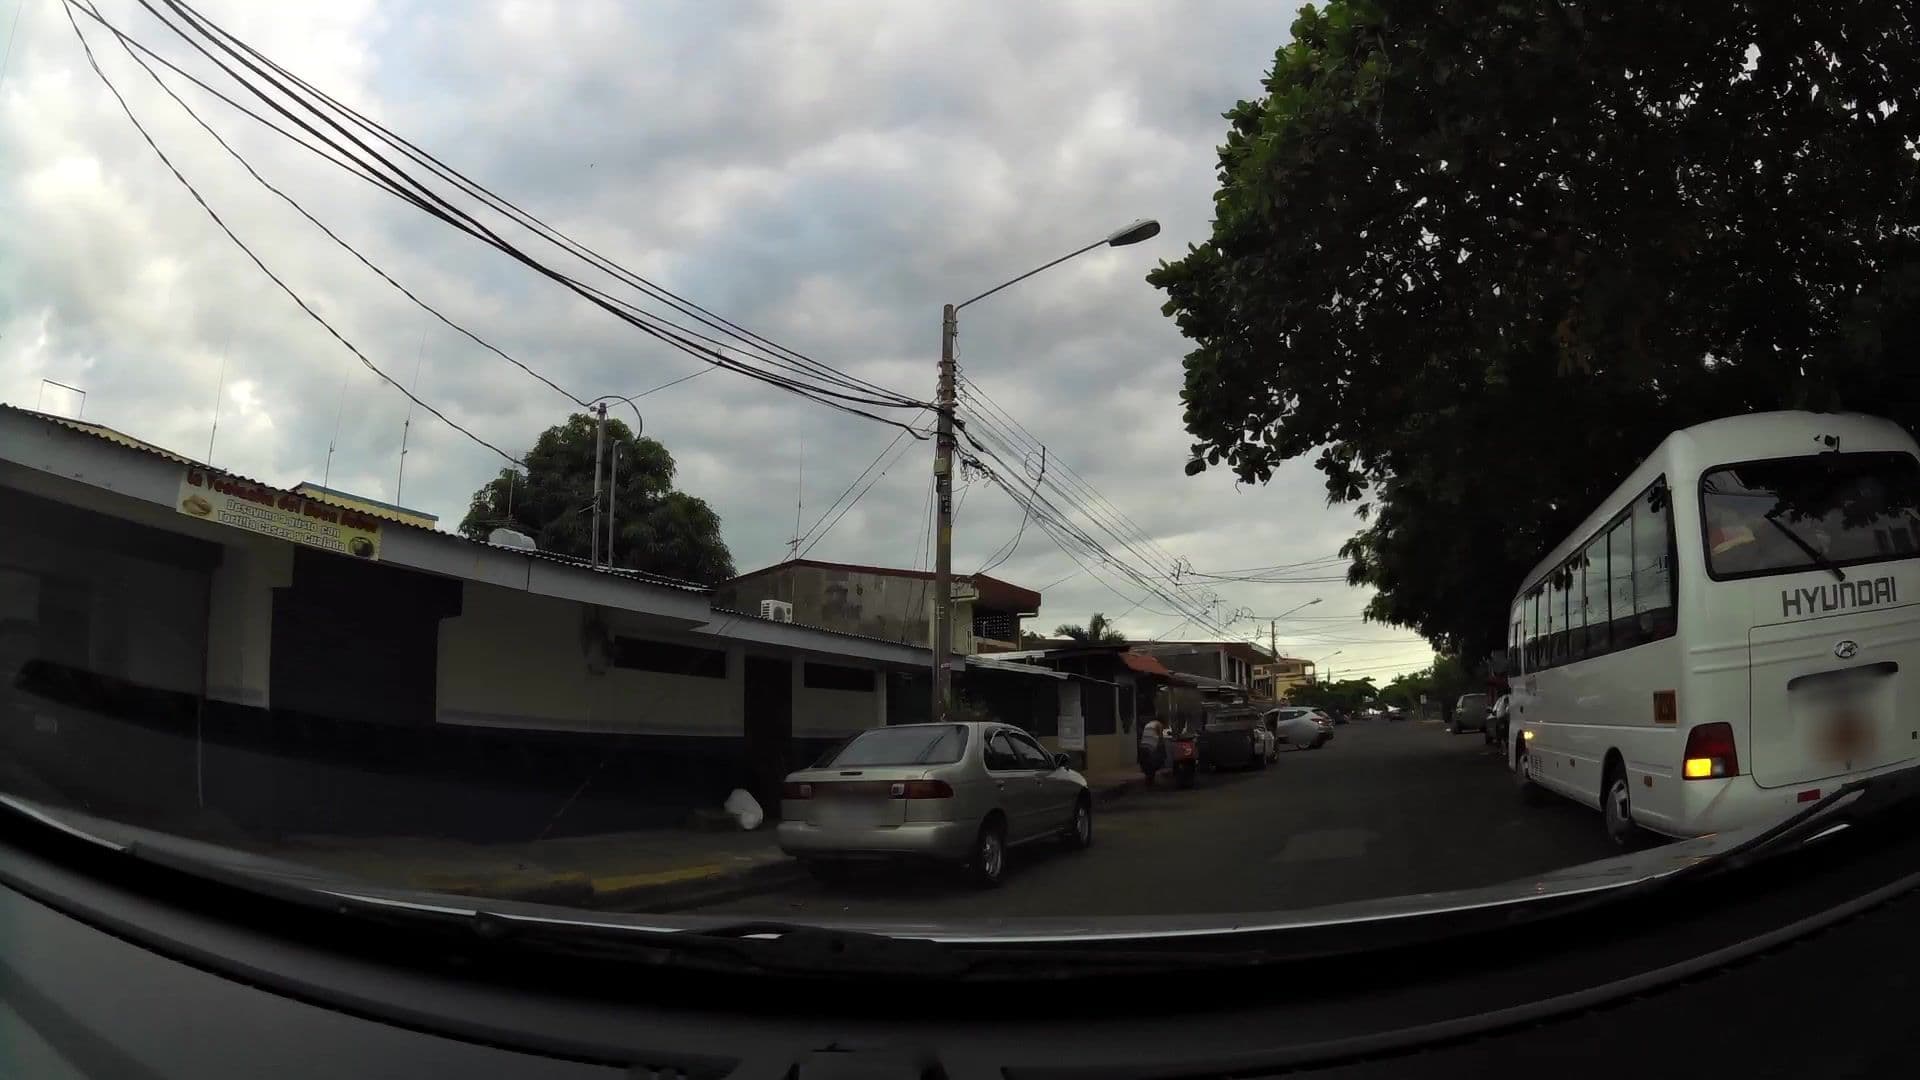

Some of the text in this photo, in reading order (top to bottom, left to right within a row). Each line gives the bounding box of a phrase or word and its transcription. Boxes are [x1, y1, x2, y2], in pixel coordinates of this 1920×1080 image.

[217, 510, 256, 531] Tortilla
[258, 522, 295, 541] Casera
[1781, 576, 1897, 617] HYUNDAI
